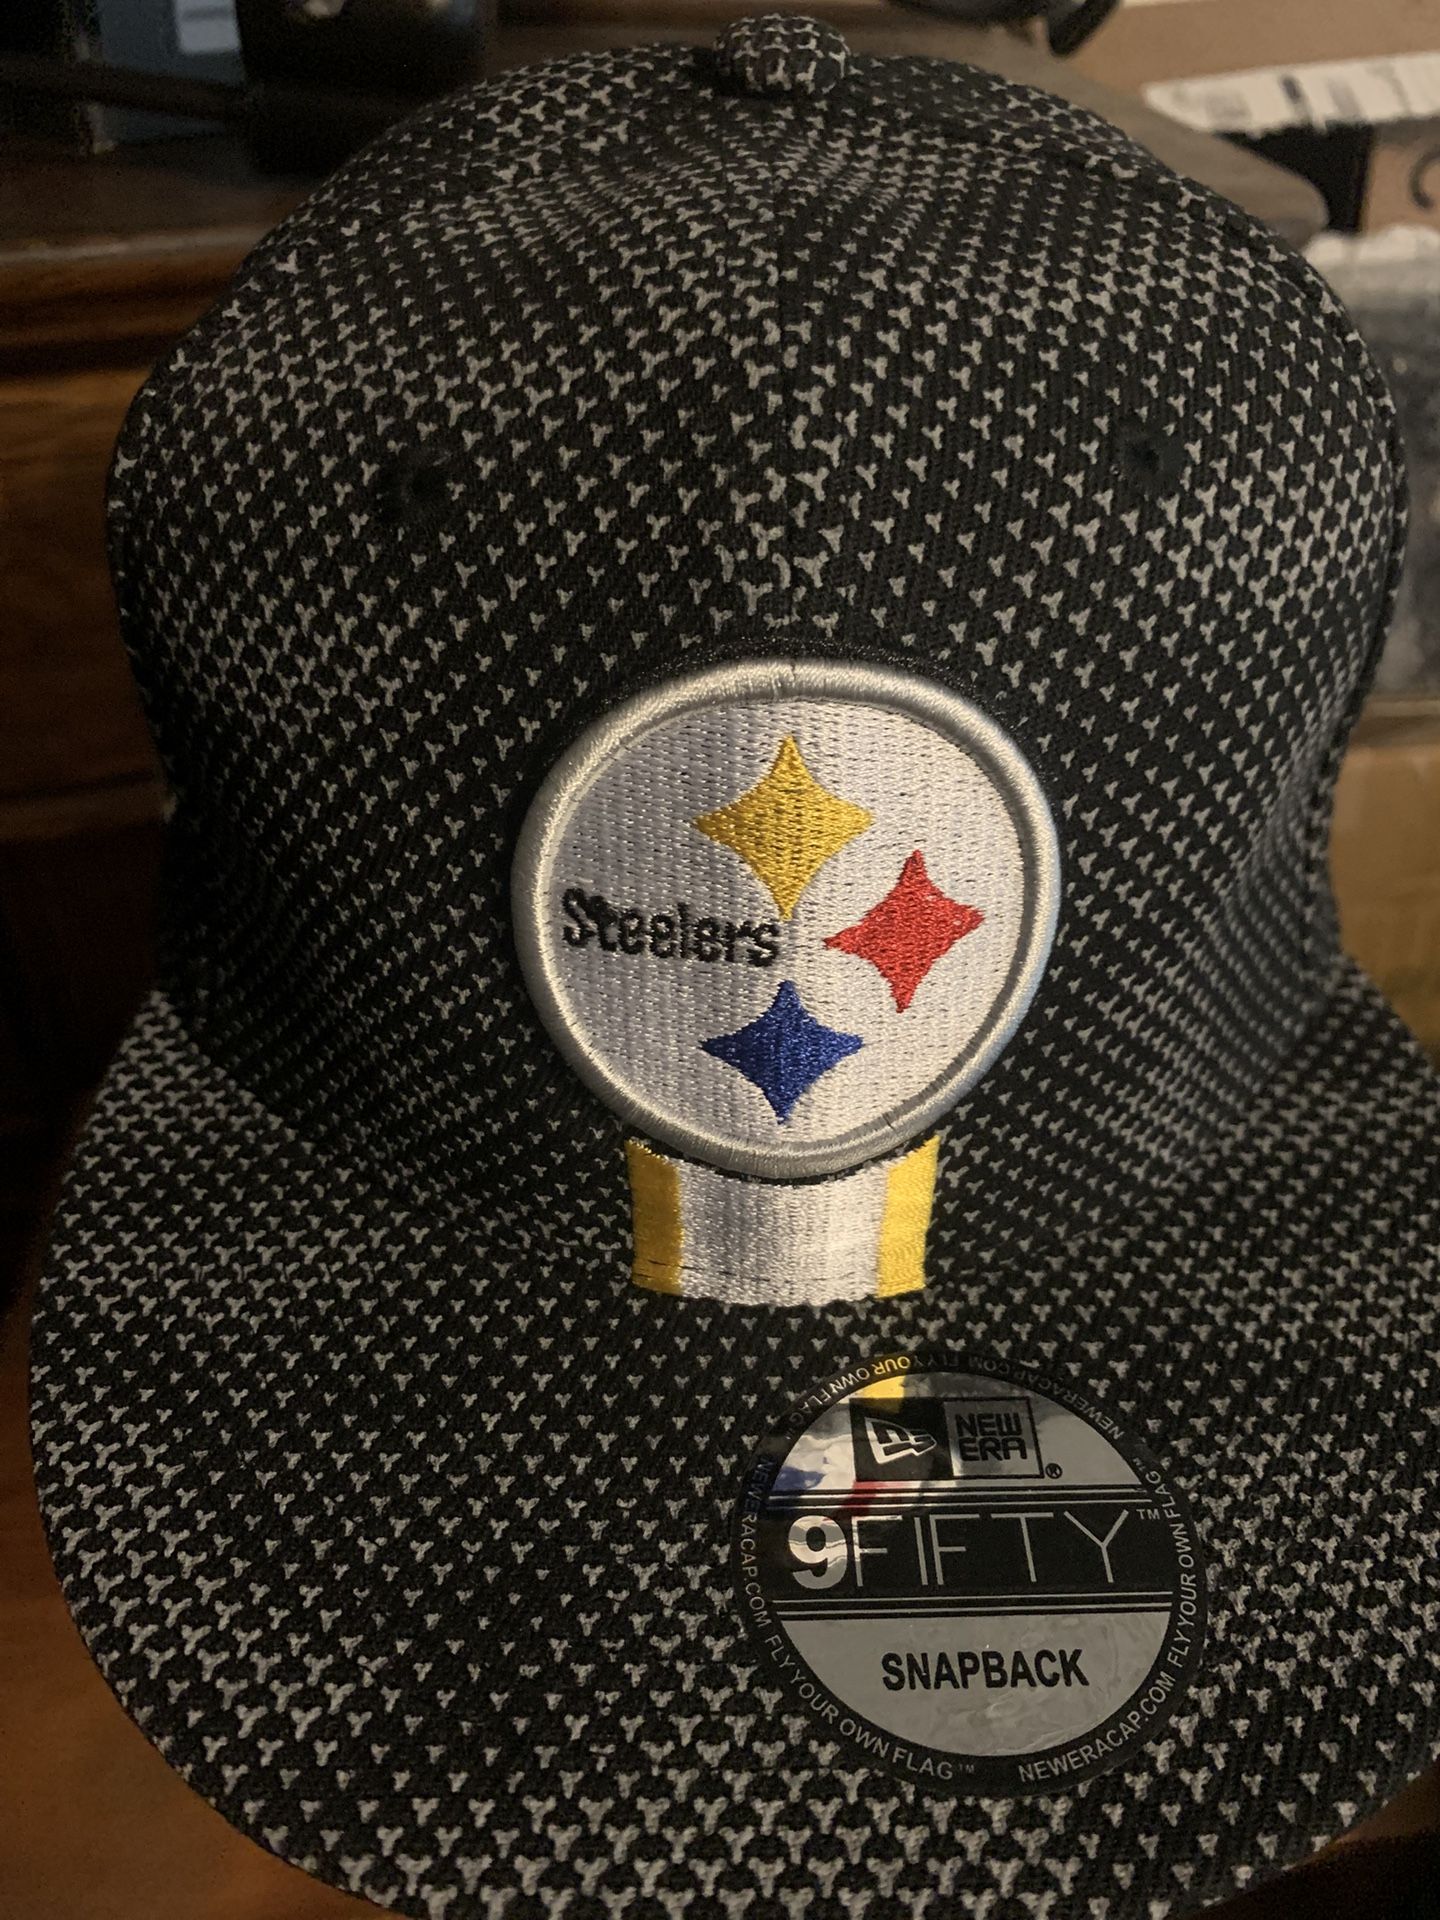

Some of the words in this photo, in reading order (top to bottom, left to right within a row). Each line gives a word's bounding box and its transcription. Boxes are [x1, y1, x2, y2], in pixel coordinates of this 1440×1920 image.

[562, 888, 780, 967] Steelers
[828, 1367, 871, 1394] OWN
[789, 1388, 831, 1425] FLAG
[955, 1412, 1022, 1436] NEW
[958, 1436, 1028, 1461] ERA
[1145, 1470, 1181, 1519] FLAG
[1170, 1522, 1195, 1569] OWN
[1177, 1573, 1197, 1629] YOUR
[881, 1648, 1090, 1691] SNAPBACK
[1167, 1629, 1191, 1667] FLY
[764, 1634, 796, 1669] FLY
[790, 1669, 839, 1724] YOUR
[839, 1718, 890, 1758] OWN
[892, 1747, 953, 1780] FLAG
[1018, 1670, 1176, 1782] NEWERACAP.COM
